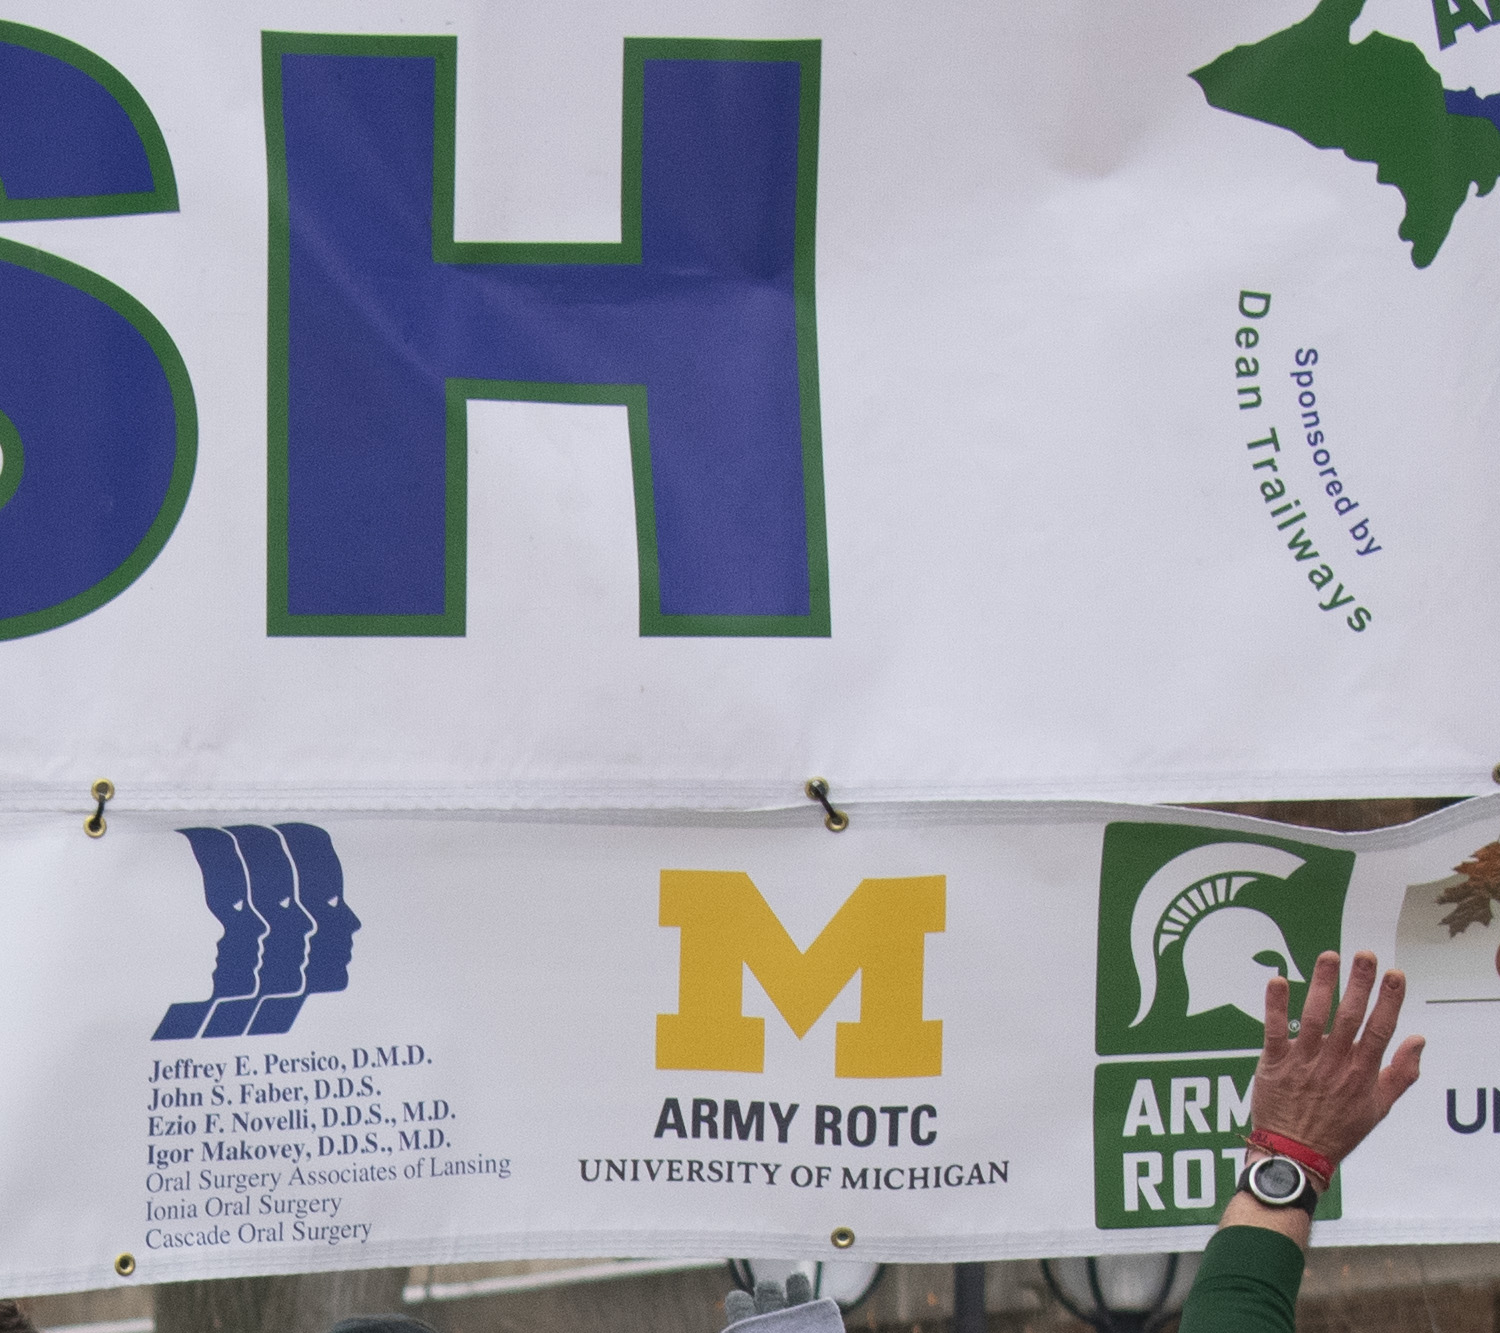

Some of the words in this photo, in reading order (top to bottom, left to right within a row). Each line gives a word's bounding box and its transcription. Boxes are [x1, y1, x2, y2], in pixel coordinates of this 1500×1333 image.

[1235, 290, 1271, 411] Dean
[1292, 348, 1360, 515] Sponsored
[1349, 513, 1382, 558] by
[1244, 427, 1373, 634] Trailways
[654, 868, 947, 1079] M
[149, 1058, 227, 1084] Jeffrey
[236, 1055, 258, 1077] E.
[264, 1051, 347, 1076] Persico,
[352, 1044, 432, 1069] D.M.D.
[148, 1086, 204, 1110] John
[211, 1084, 232, 1107] S.
[239, 1081, 309, 1106] Faber,
[314, 1076, 381, 1100] D.D.S.
[1122, 1075, 1256, 1137] ARM
[148, 1114, 197, 1137] Ezio
[204, 1112, 225, 1134] F.
[231, 1108, 316, 1133] Novelli,
[322, 1104, 396, 1128] D.D.S.,
[402, 1098, 456, 1123] M.D.
[653, 1097, 801, 1145] ARMY
[814, 1104, 938, 1148] ROTC
[148, 1144, 194, 1169] Igor
[200, 1138, 311, 1166] Makovey,
[317, 1133, 393, 1158] D.D.S.,
[398, 1128, 451, 1151] M.D.
[146, 1168, 191, 1193] Oral
[199, 1168, 282, 1193] Surgery
[288, 1161, 397, 1186] Associates
[403, 1158, 425, 1180] of
[430, 1154, 512, 1180] Lansing
[579, 1158, 782, 1190] UNIVERSITY
[790, 1163, 832, 1190] OF
[840, 1159, 1011, 1193] MICHIGAN
[1122, 1148, 1247, 1212] ROT
[145, 1198, 198, 1221] Ionia
[205, 1195, 251, 1218] Oral
[258, 1194, 342, 1219] Surgery
[145, 1225, 231, 1250] Cascade
[238, 1222, 284, 1245] Oral
[292, 1221, 373, 1246] Surgery
